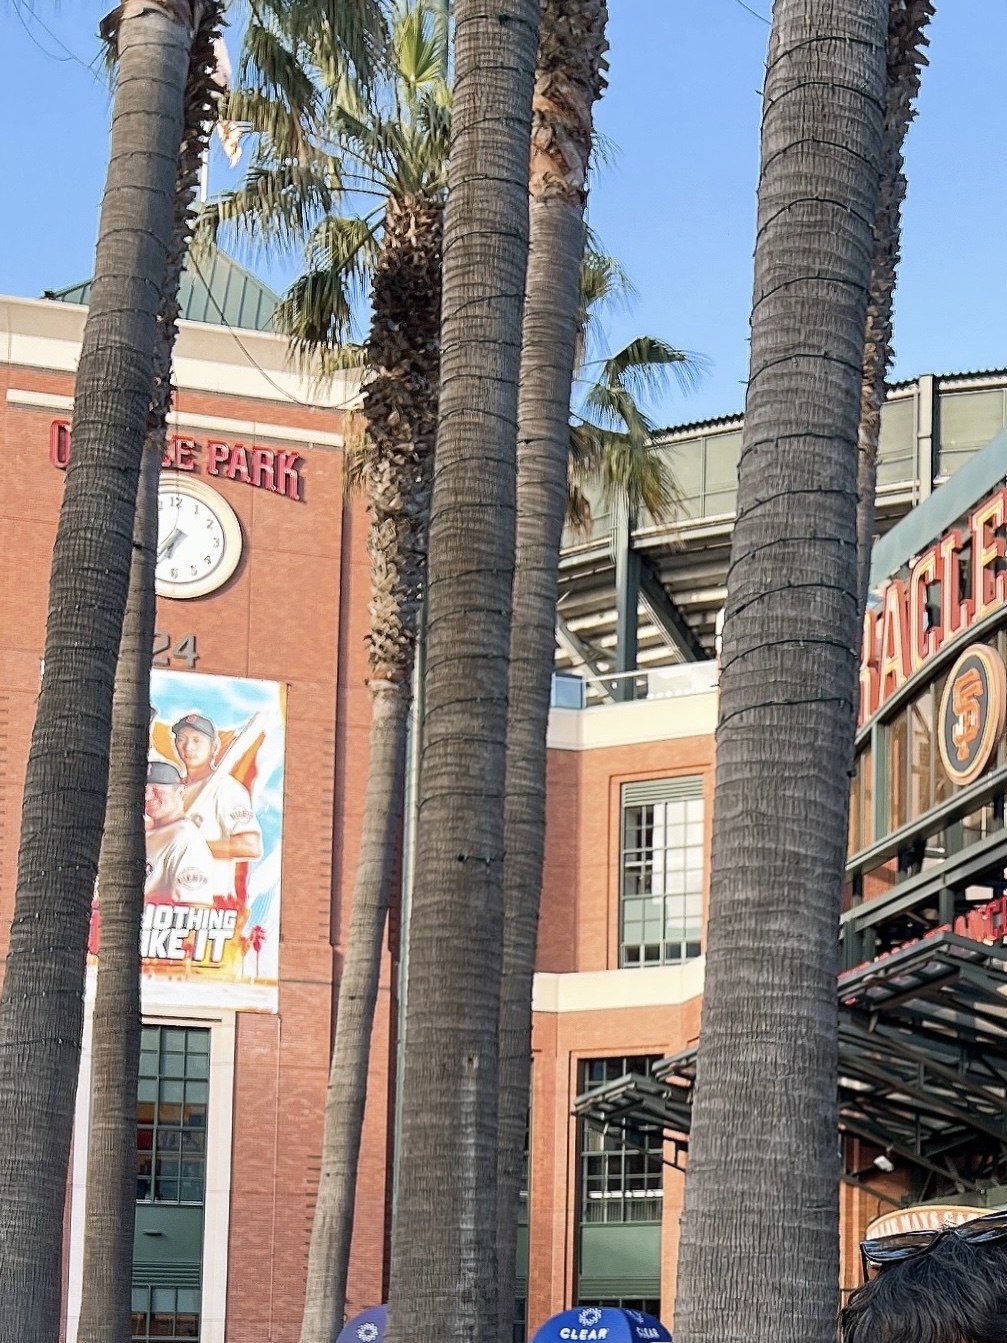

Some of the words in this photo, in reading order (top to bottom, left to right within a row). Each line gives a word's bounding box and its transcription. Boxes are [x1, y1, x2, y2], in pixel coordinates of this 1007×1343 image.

[206, 439, 301, 500] PARK
[153, 632, 199, 668] 24
[140, 928, 189, 960] IKE
[193, 929, 236, 963] IT
[560, 1327, 608, 1341] CLEAR
[636, 1326, 660, 1340] CLEAR
